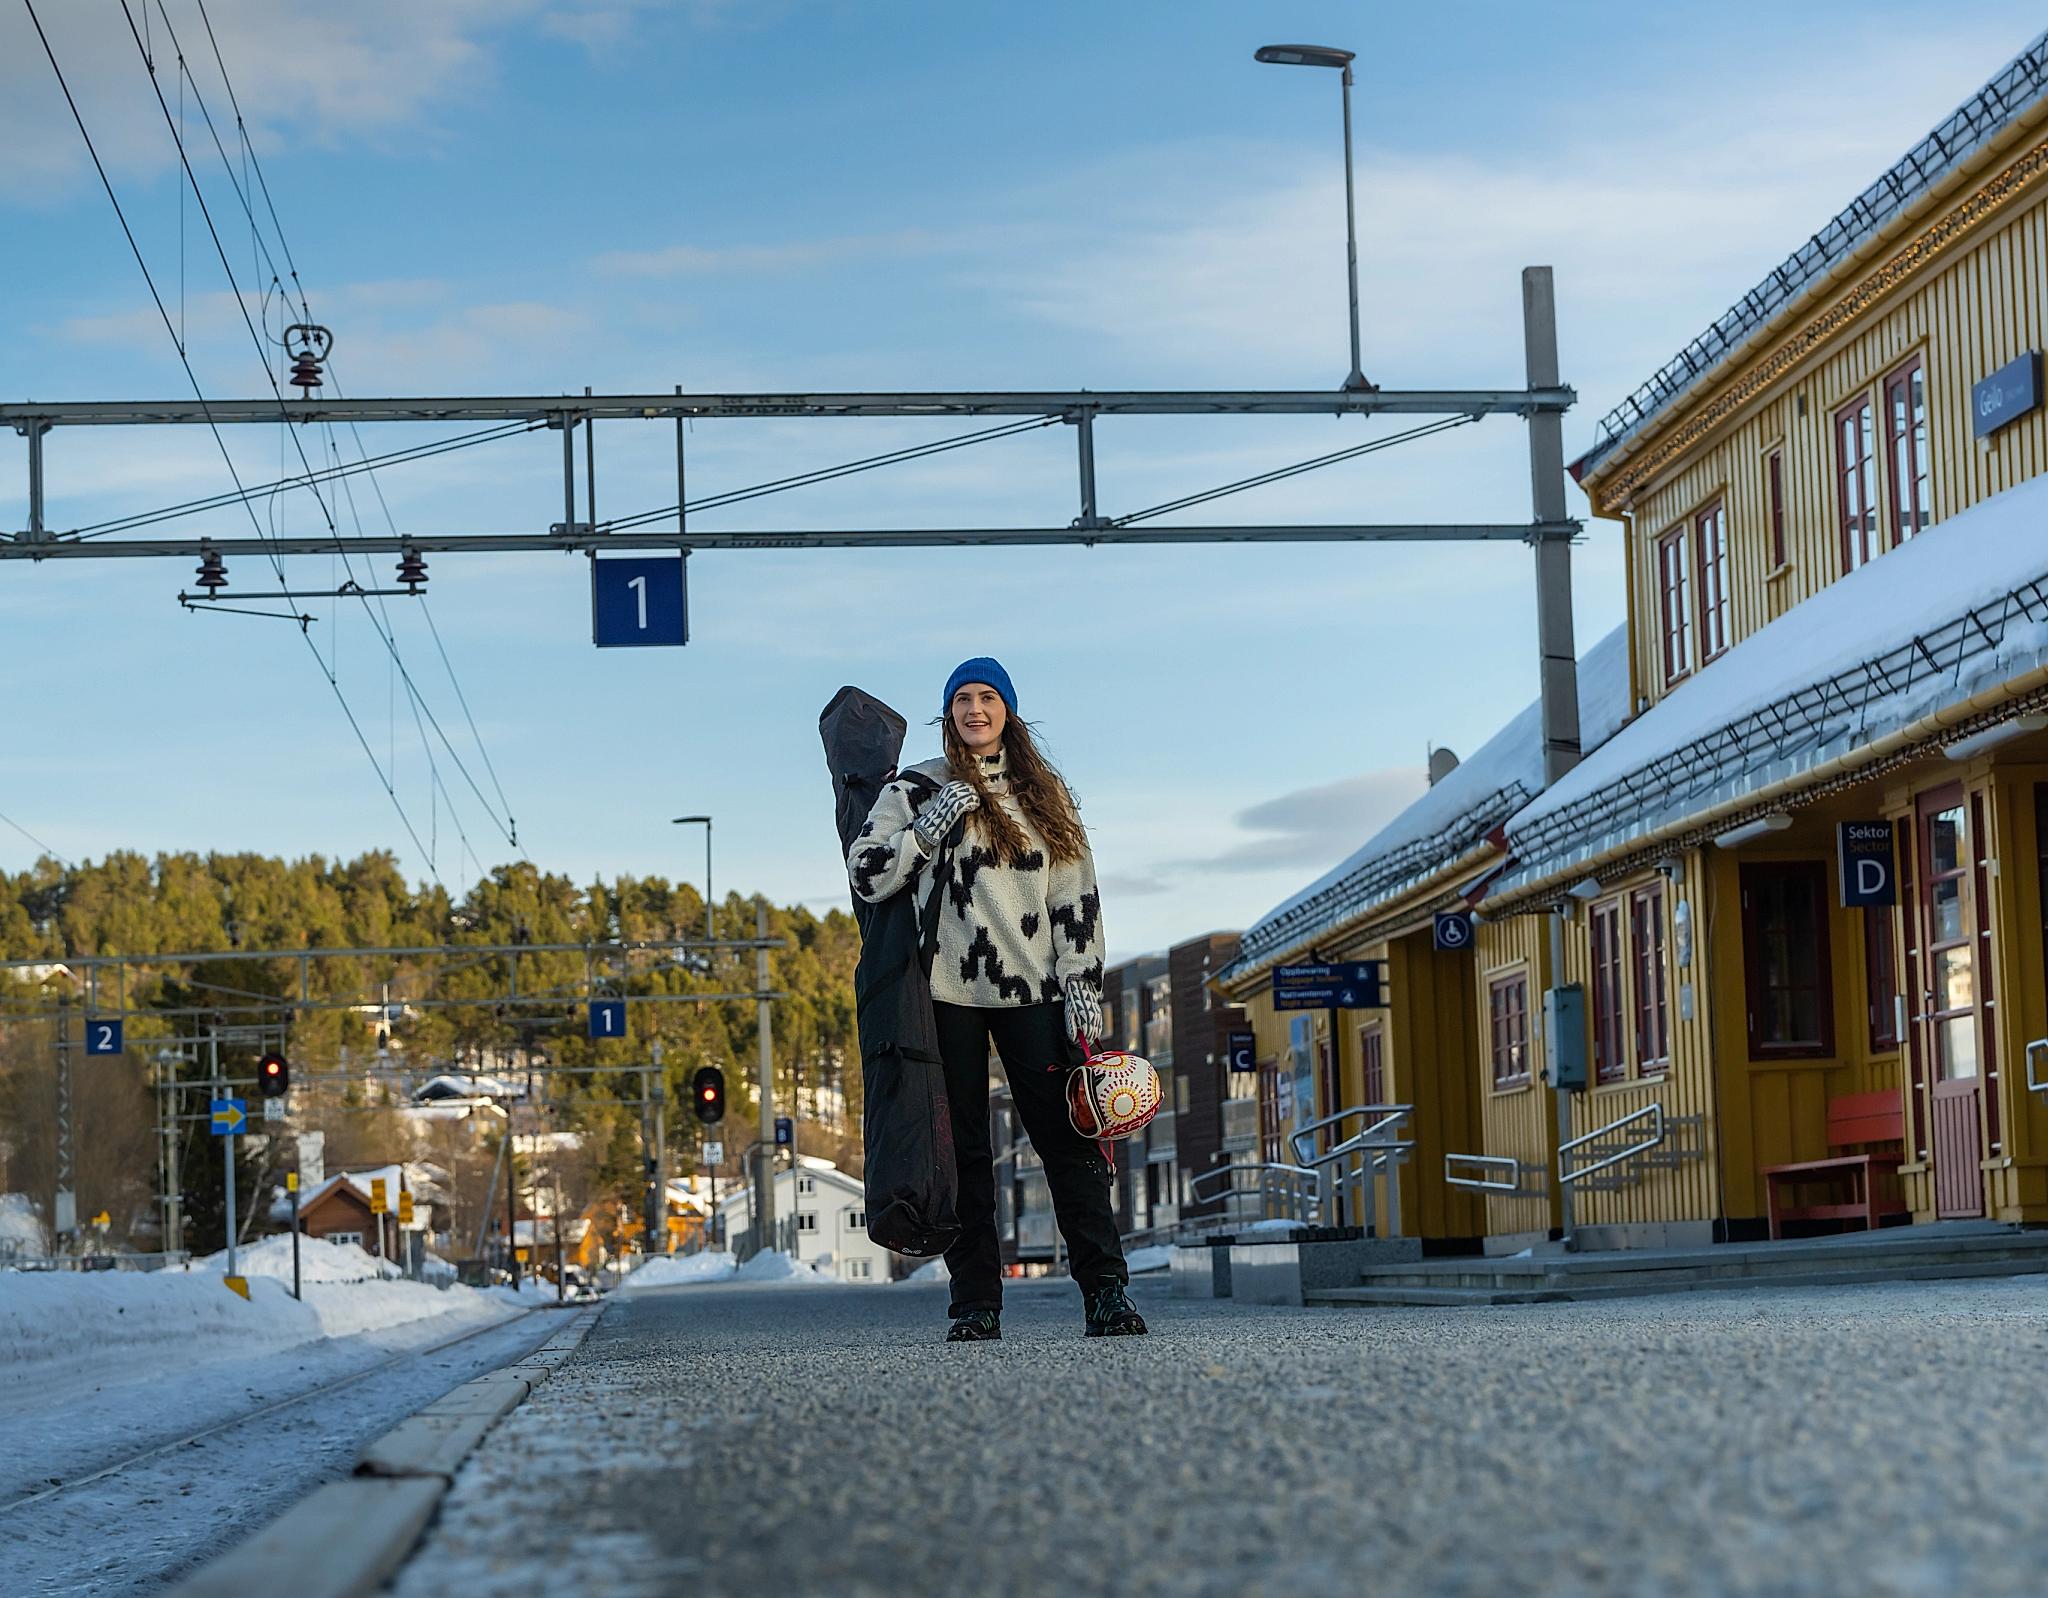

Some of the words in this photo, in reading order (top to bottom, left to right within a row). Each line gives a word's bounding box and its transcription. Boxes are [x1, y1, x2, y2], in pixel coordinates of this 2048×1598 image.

[627, 576, 647, 629] 1
[1848, 825, 1890, 839] Sektor
[1857, 859, 1886, 894] D
[602, 1008, 612, 1032] 1
[97, 1026, 113, 1050] 2
[1235, 1049, 1250, 1069] C
